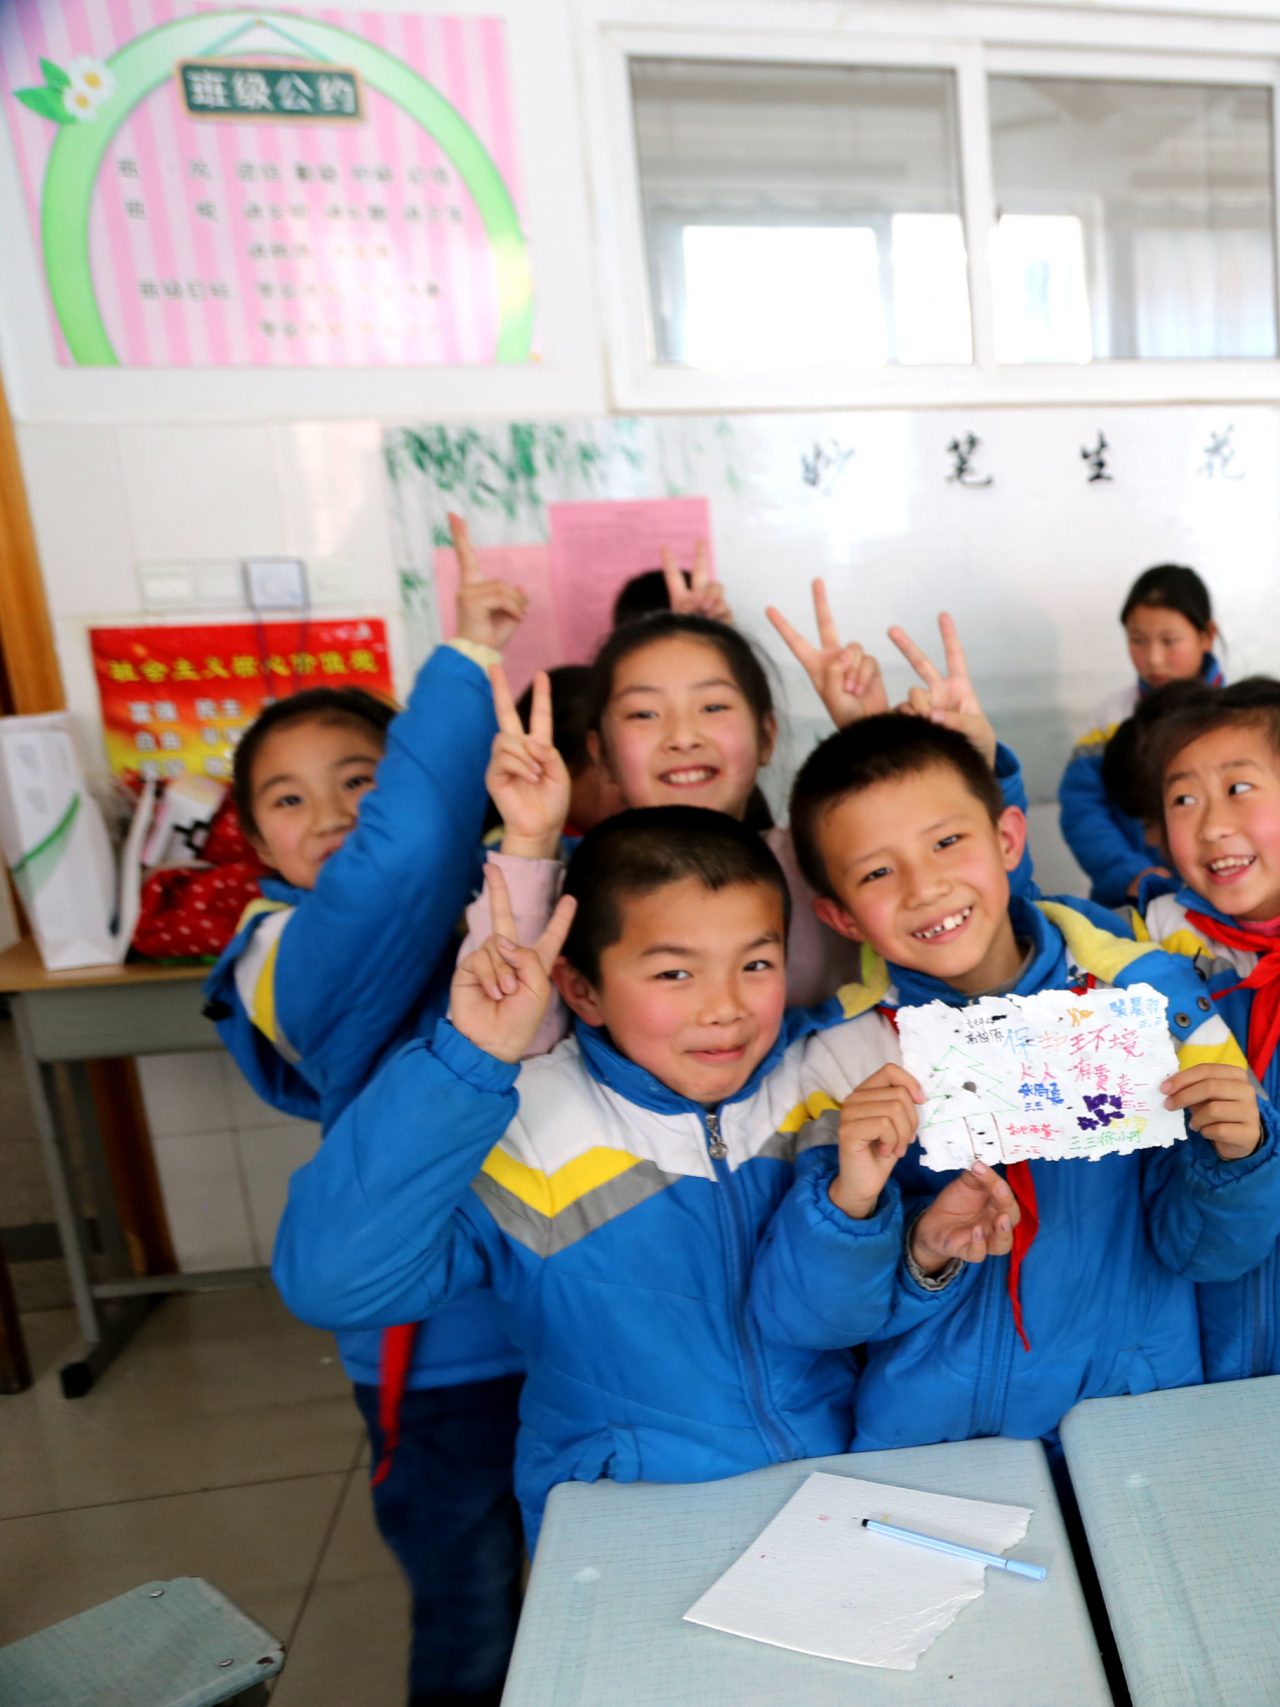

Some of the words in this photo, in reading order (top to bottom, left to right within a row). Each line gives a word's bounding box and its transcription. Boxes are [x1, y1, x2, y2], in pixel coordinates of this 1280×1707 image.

[187, 70, 356, 113] 班级公约
[109, 649, 379, 682] 社会主义核心价值观
[1004, 1025, 1145, 1061] 保护环境
